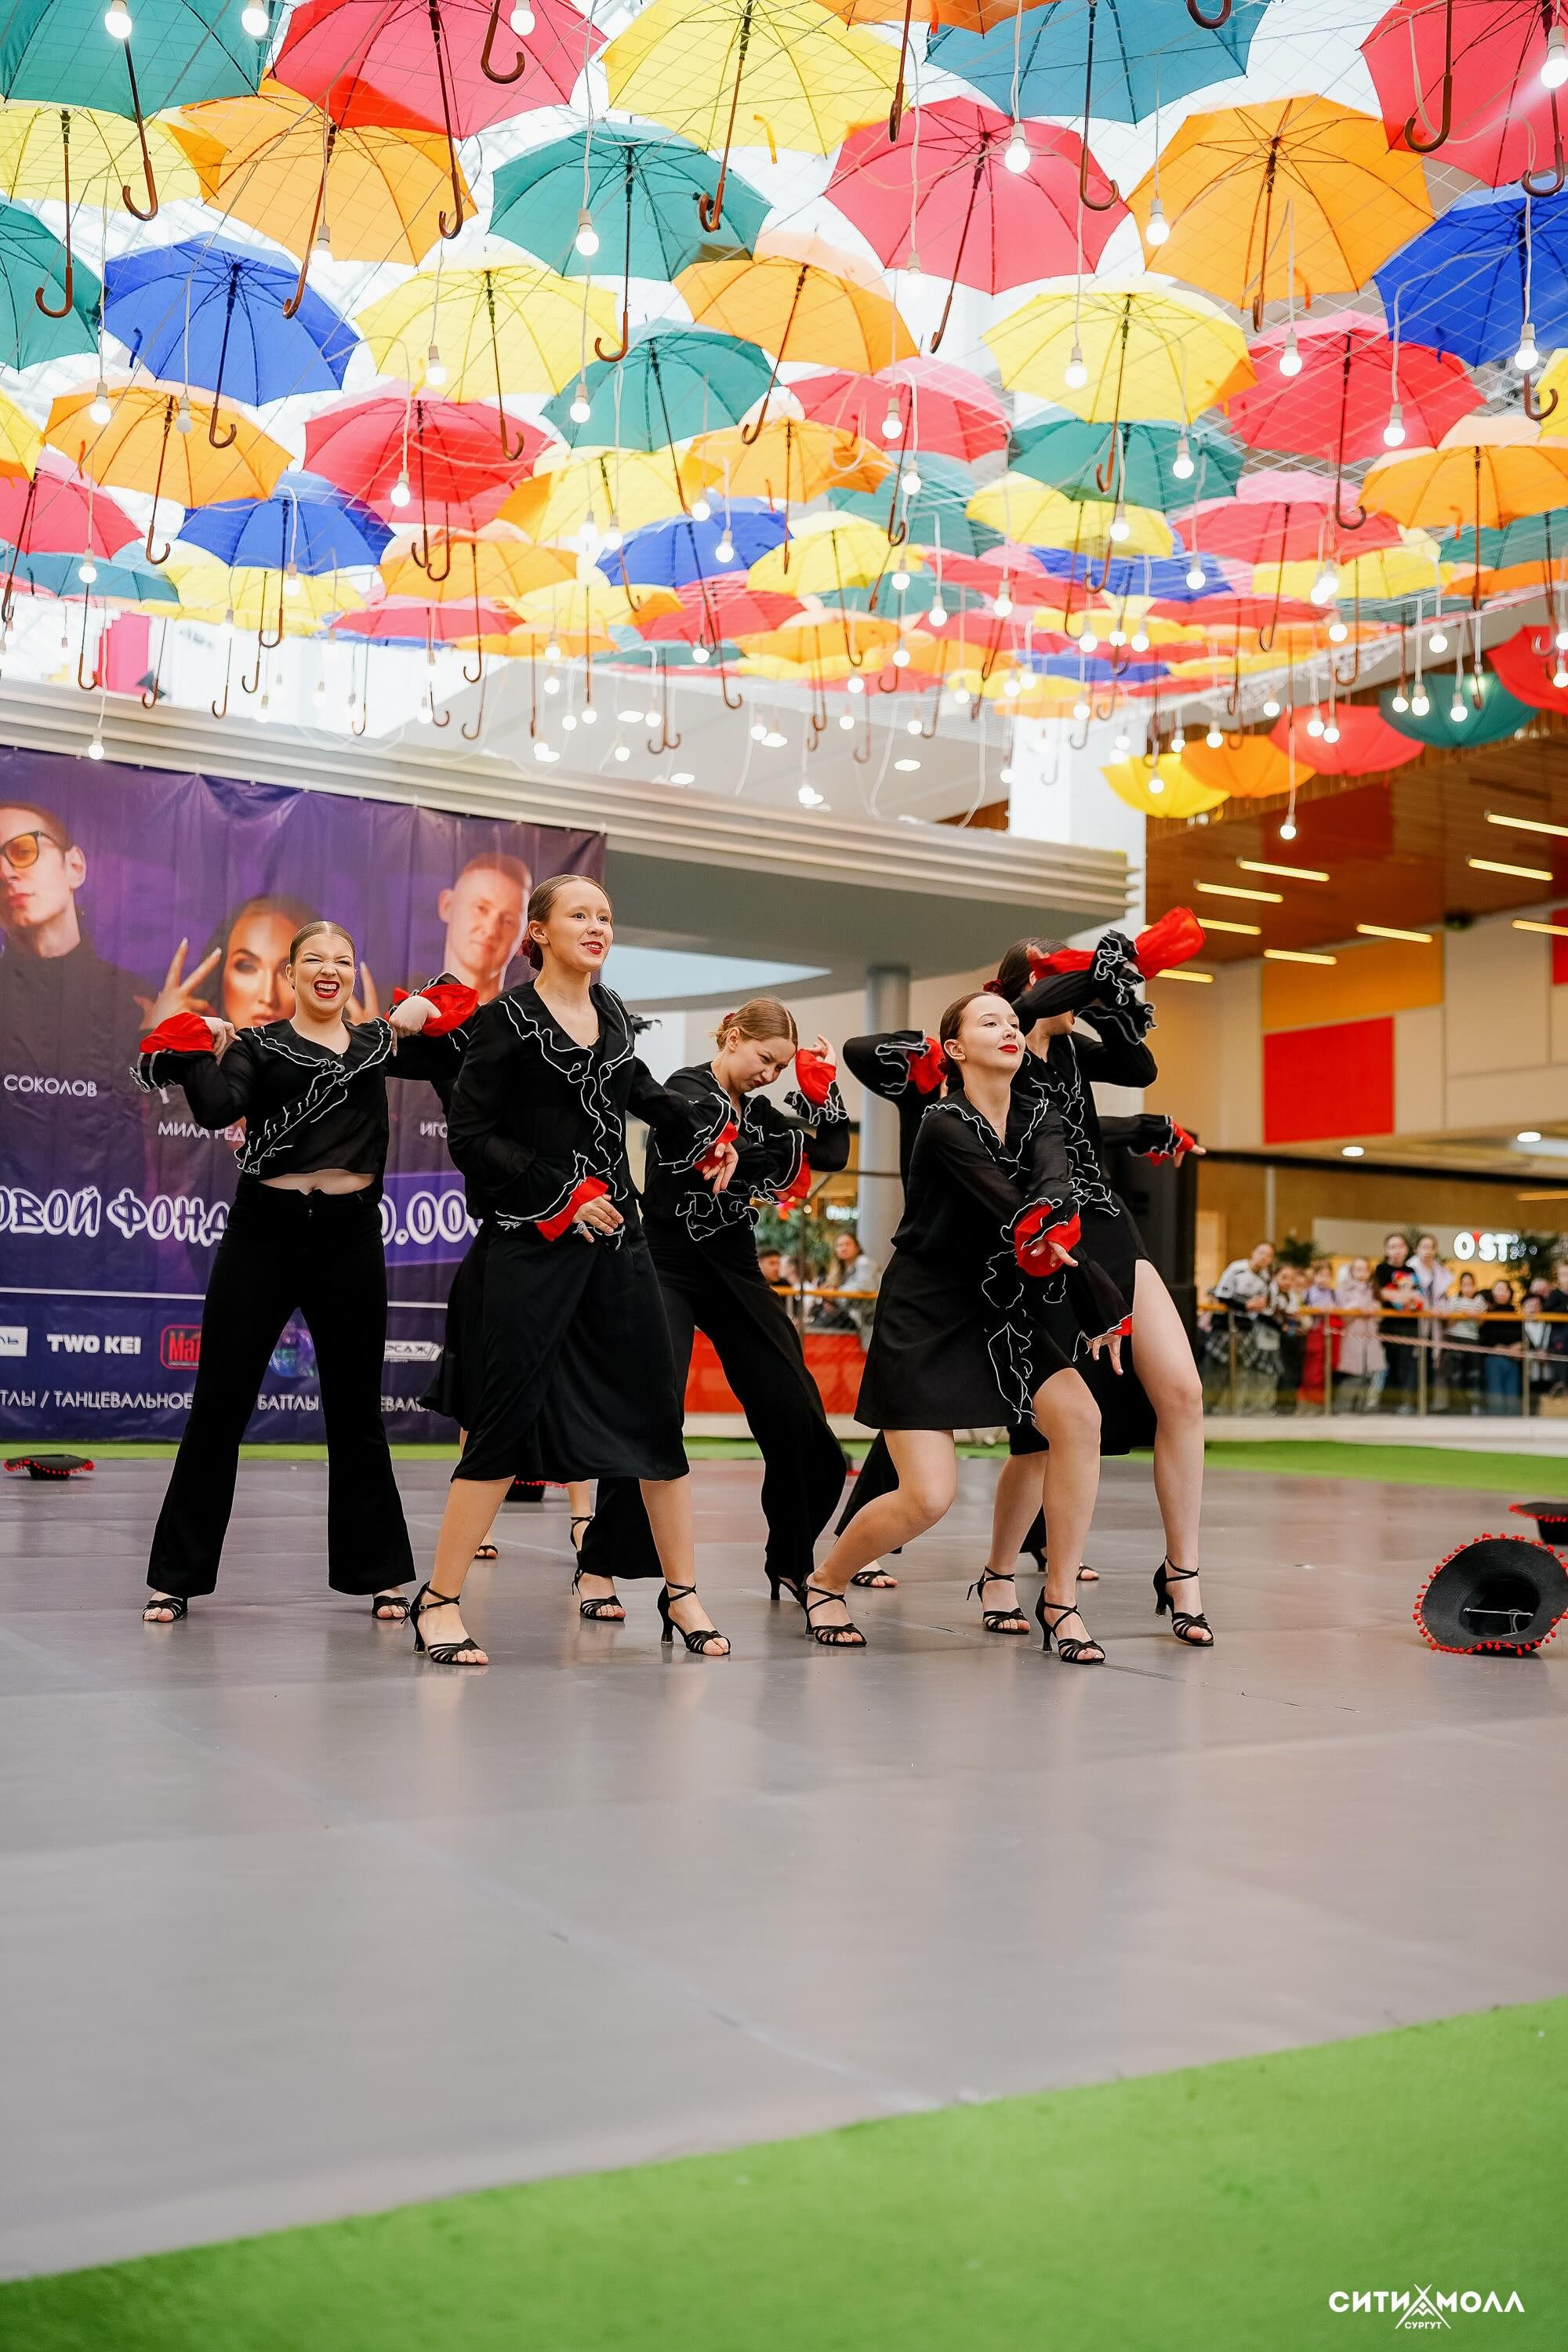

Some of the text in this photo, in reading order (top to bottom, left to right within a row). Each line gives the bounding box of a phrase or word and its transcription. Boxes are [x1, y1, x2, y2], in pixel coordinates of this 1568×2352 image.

[3, 1074, 98, 1098] СОКОЛОВ
[158, 1121, 210, 1140] МИЛА
[46, 1333, 142, 1355] TWO KEI
[53, 1391, 194, 1410] ТАНЦЕВАЛЬНОЕ
[257, 1393, 319, 1411] БАТТЛЫ
